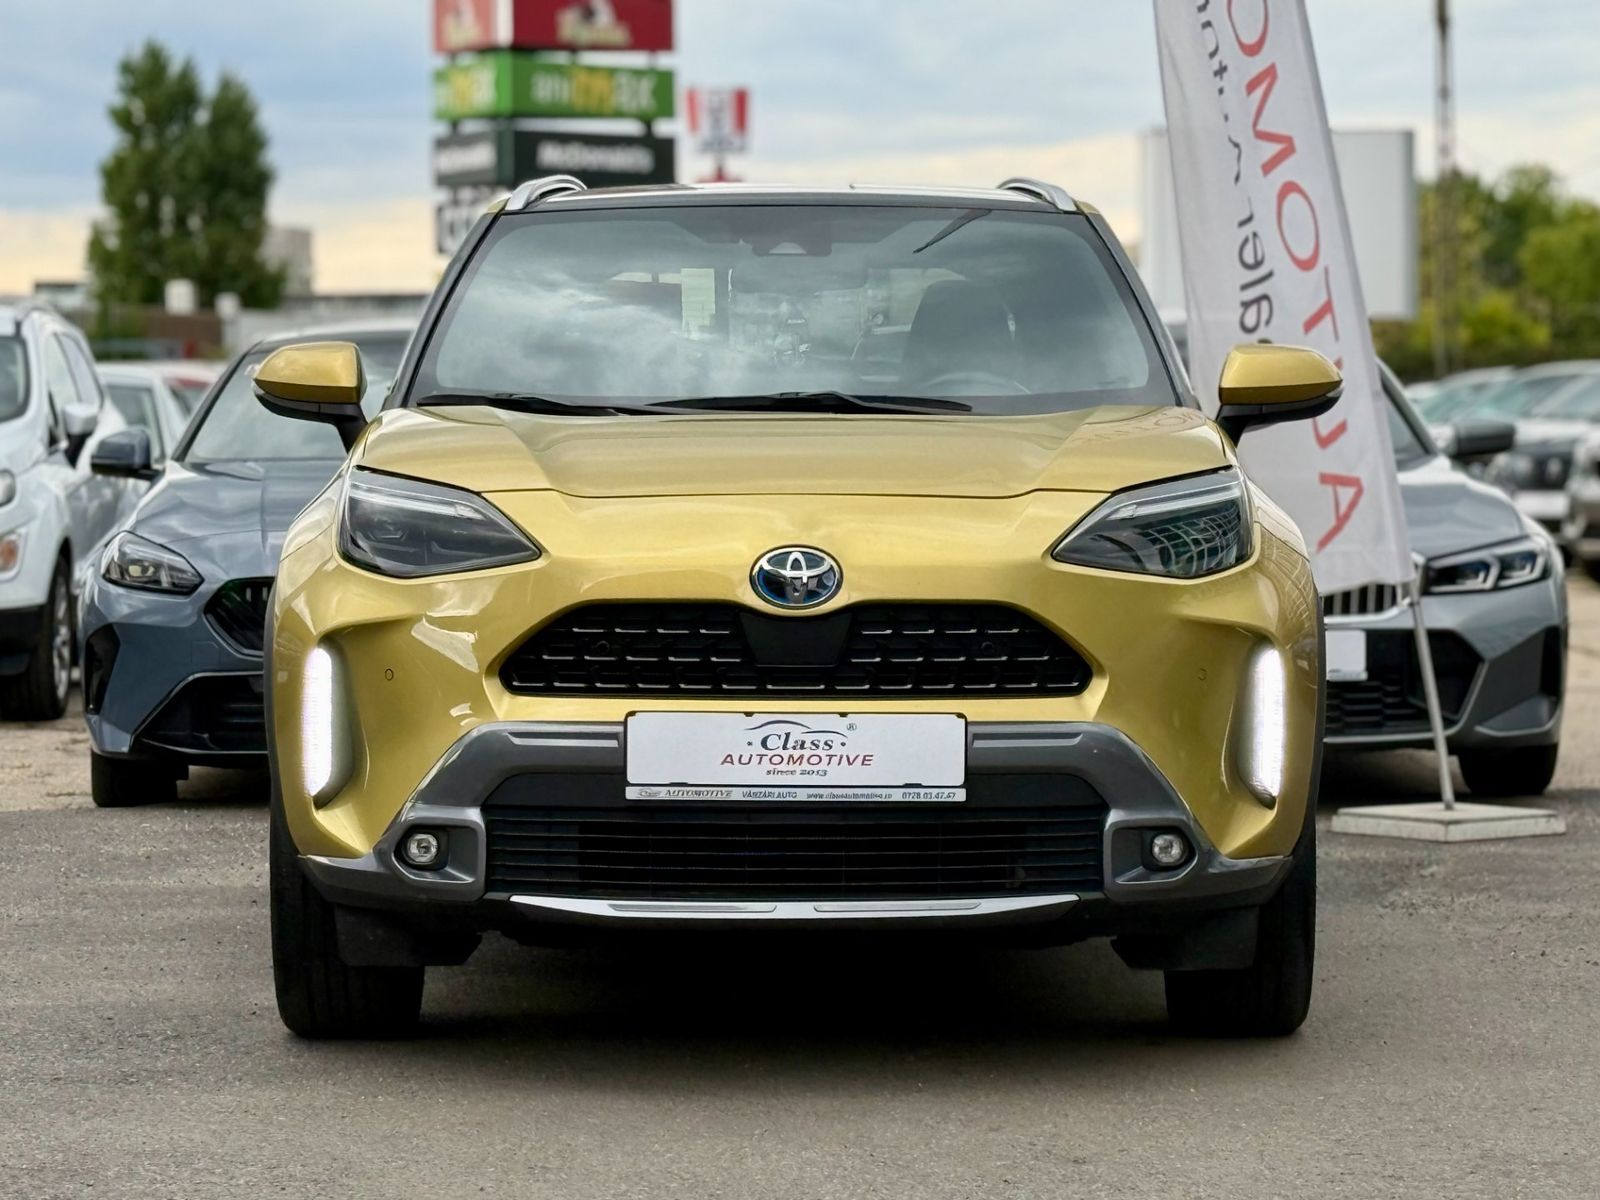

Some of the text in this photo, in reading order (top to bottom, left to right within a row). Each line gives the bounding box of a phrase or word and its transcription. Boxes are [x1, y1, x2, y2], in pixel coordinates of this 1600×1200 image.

[760, 732, 834, 751] Class
[720, 754, 874, 767] AUTOMOTIVE
[765, 768, 797, 776] since
[776, 791, 798, 799] AUTO
